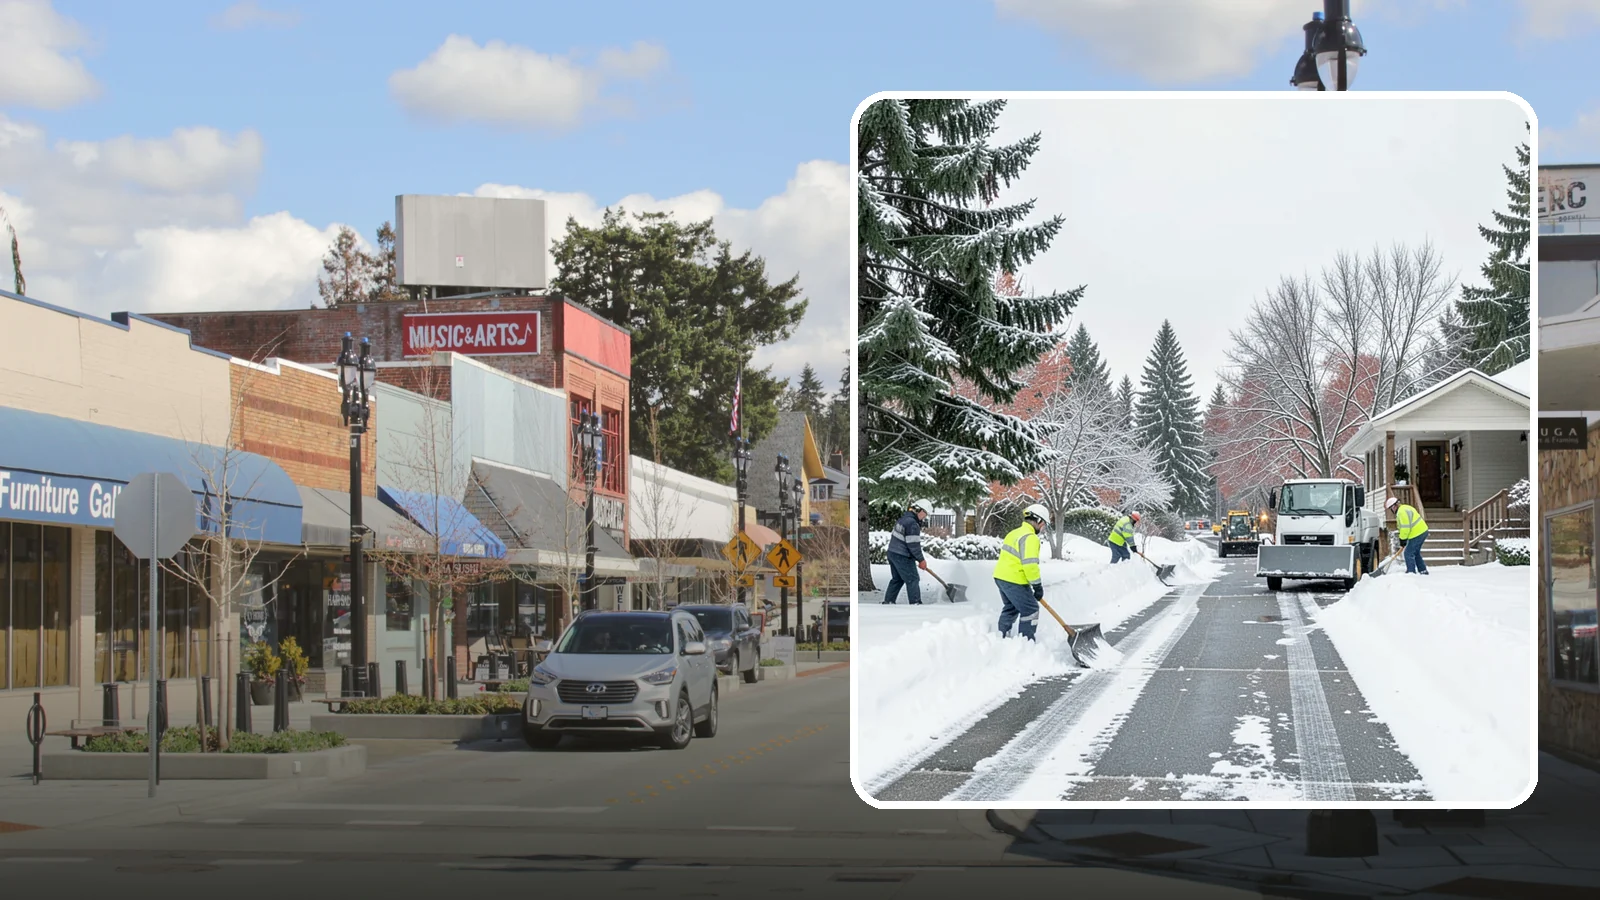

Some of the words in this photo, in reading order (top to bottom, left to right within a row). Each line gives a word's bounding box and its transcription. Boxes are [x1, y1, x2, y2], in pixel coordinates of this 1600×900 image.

[409, 323, 519, 348] MUSIC&ARTS
[0, 471, 79, 516] Furniture
[453, 563, 480, 574] SUSHI
